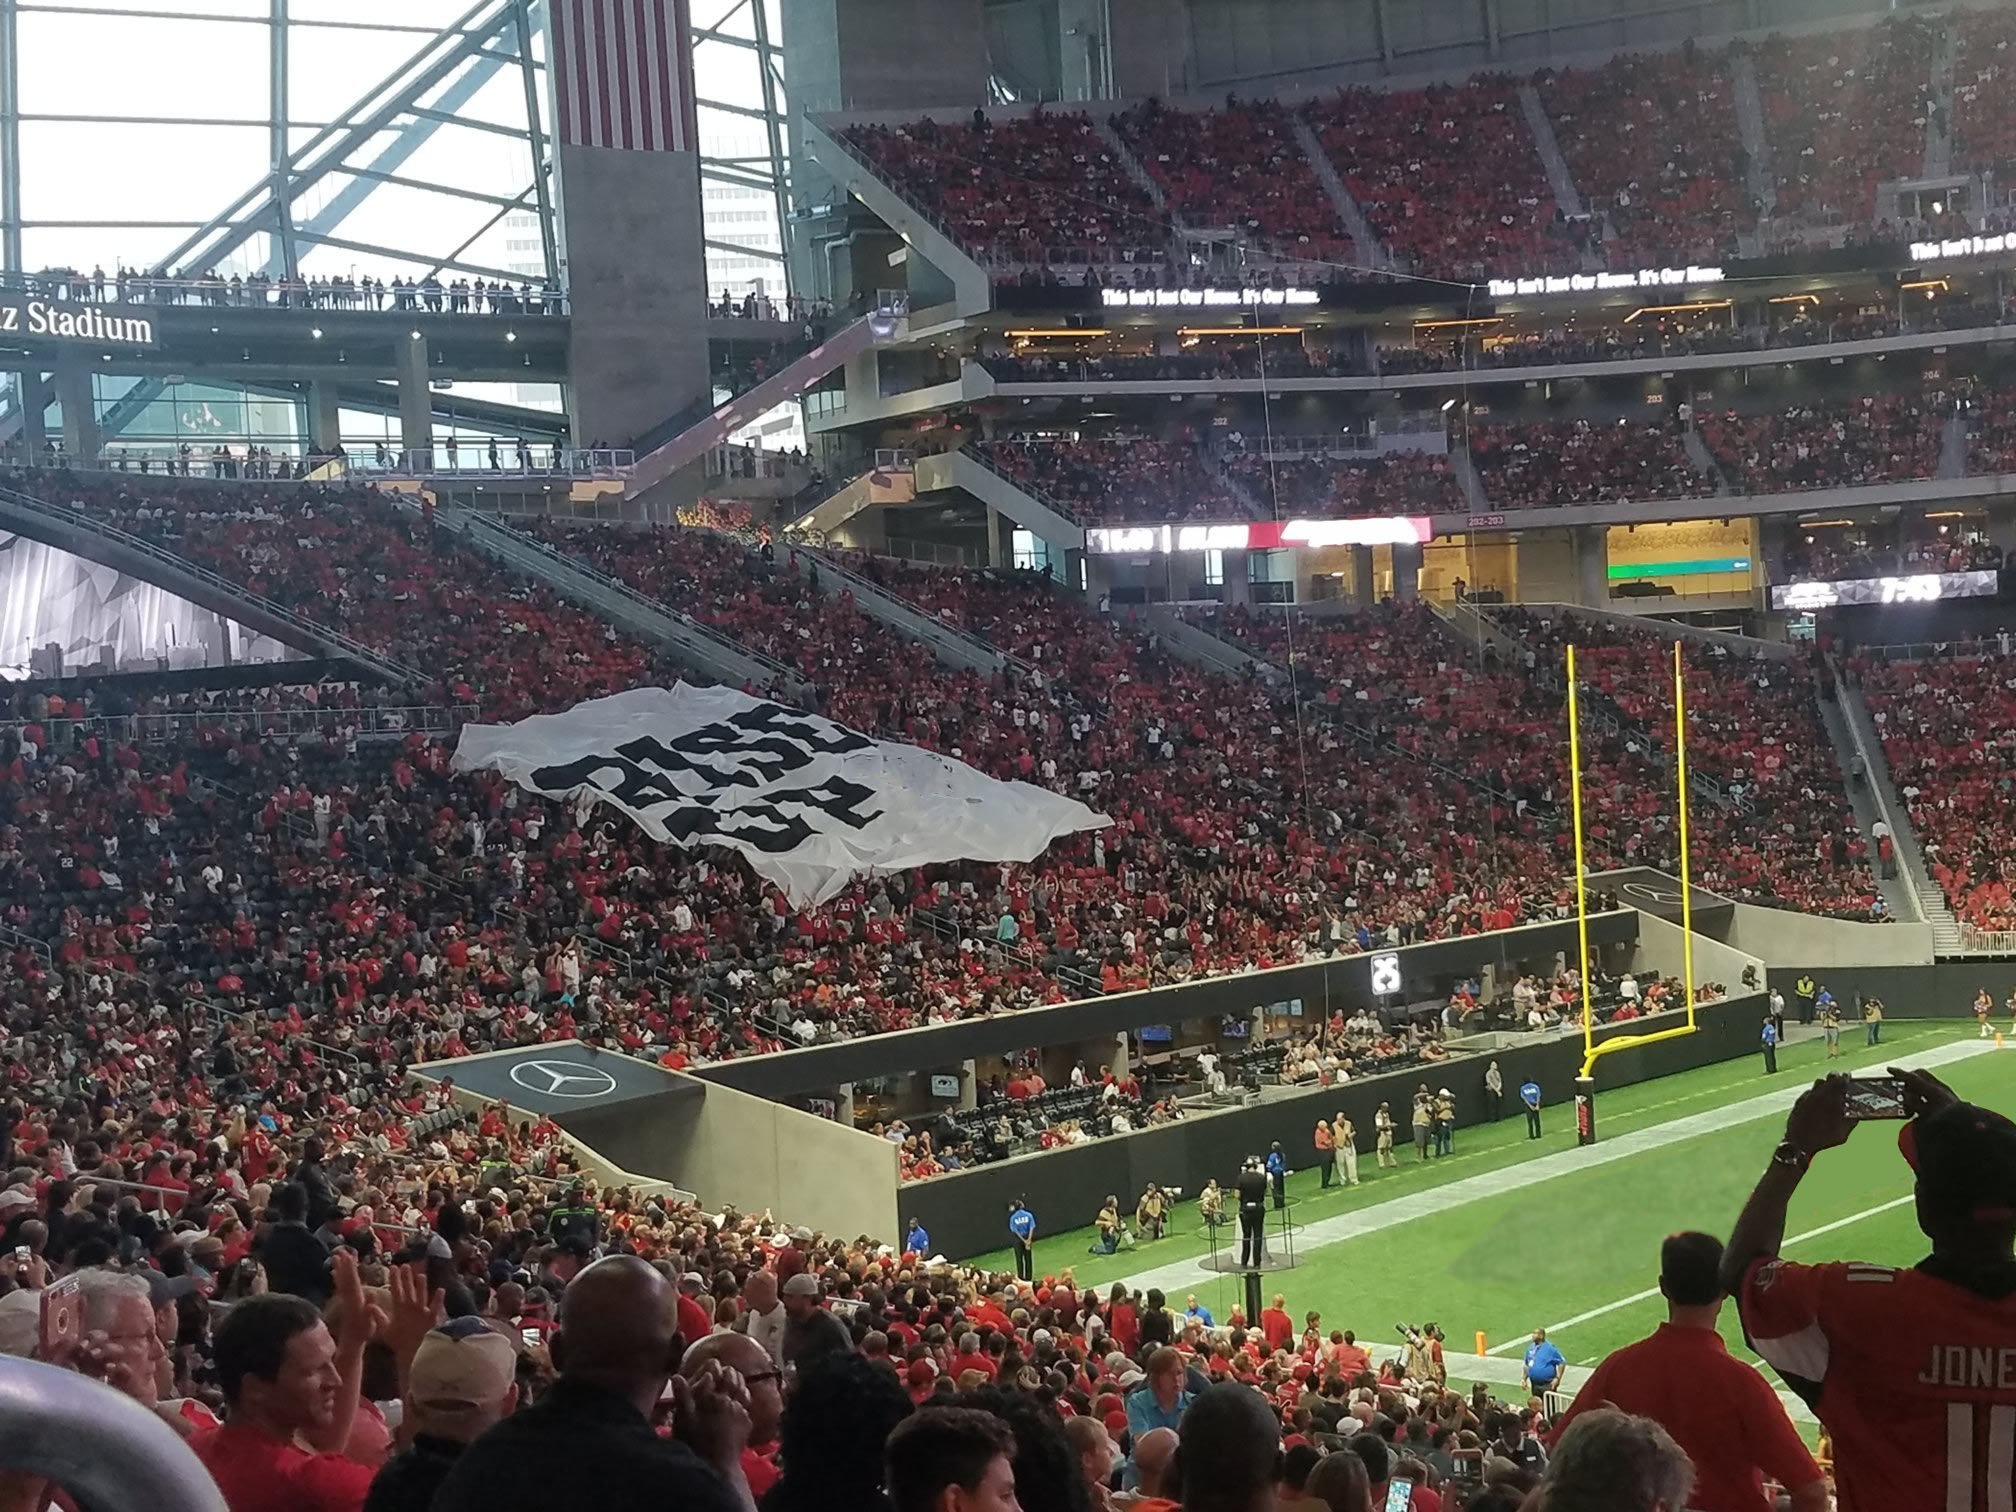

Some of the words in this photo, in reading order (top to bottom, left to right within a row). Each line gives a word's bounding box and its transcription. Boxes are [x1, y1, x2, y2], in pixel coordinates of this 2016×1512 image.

[1910, 242, 1941, 261] This
[1487, 279, 1516, 296] This
[1545, 276, 1570, 293] Just
[1570, 274, 1597, 291] Our
[1660, 267, 1686, 284] Our
[1101, 288, 1128, 306] This
[1156, 289, 1179, 306] Just
[1179, 288, 1203, 305] Our
[1261, 288, 1285, 305] Our
[27, 301, 152, 342] Stadium
[1647, 394, 1663, 404] 203
[1469, 516, 1504, 526] 202-203
[61, 857, 74, 868] 22
[1919, 1344, 2016, 1388] JONE
[1946, 1403, 2016, 1512] 11
